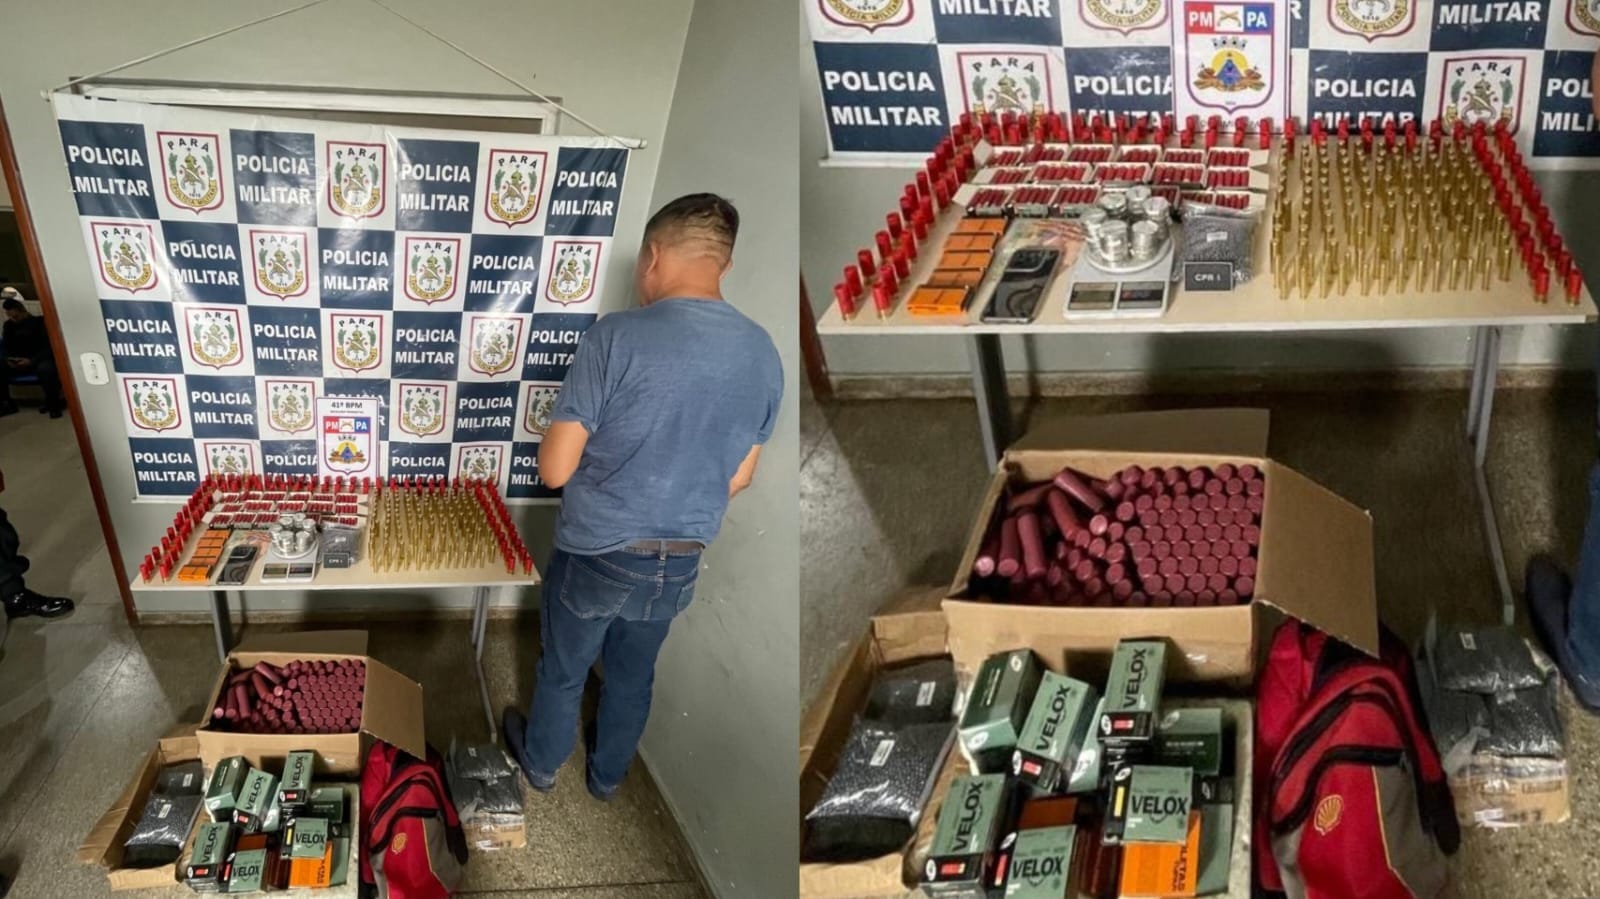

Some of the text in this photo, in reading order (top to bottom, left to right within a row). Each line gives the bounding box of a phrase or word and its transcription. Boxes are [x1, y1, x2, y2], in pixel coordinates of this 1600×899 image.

[938, 0, 1051, 18] MILITAR
[1440, 2, 1540, 25] MILITAR
[1189, 11, 1212, 27] PM
[1246, 12, 1266, 27] PA
[824, 71, 936, 92] POLICIA
[1074, 75, 1172, 95] POLICIA
[1315, 78, 1416, 98] POLICIA
[832, 106, 942, 126] MILITAR
[1542, 112, 1594, 131] MILI
[68, 144, 144, 166] POLICIA
[236, 154, 310, 176] POLICIA
[402, 164, 470, 182] POLICIA
[74, 176, 150, 198] MILITAR
[557, 170, 618, 188] POLICIA
[239, 185, 312, 205] MILITAR
[400, 194, 470, 212] MILITAR
[552, 200, 613, 216] MILITAR
[170, 242, 236, 260] POLICIA
[322, 249, 389, 266] POLICIA
[472, 255, 534, 270] POLICIA
[173, 268, 240, 286] MILITAR
[324, 276, 389, 292] MILITAR
[470, 279, 533, 295] MILITAR
[105, 318, 172, 334] POLICIA
[254, 324, 316, 339] POLICIA
[396, 328, 456, 343] POLICIA
[111, 342, 176, 357] MILITAR
[257, 347, 318, 362] MILITAR
[395, 351, 454, 364] MILITAR
[527, 352, 576, 365] MILITA
[192, 391, 252, 405] POLICIA
[459, 396, 512, 409] POLICIA
[194, 412, 254, 425] MILITAR
[325, 421, 339, 430] PM
[356, 421, 367, 430] PA
[457, 416, 510, 428] MILITAR
[134, 453, 192, 465] POLICIA
[392, 457, 445, 467] POLICIA
[138, 471, 196, 482] MILITAR
[1123, 648, 1146, 708] VELOX
[1036, 684, 1071, 750] VELOX
[292, 756, 304, 788] VELOX
[246, 775, 264, 811] VELOX
[1131, 795, 1188, 816] VELOX
[952, 782, 984, 852] VELOX
[202, 826, 218, 863] VELOX
[295, 833, 325, 844] VELOX
[233, 864, 260, 877] VELOX
[1012, 856, 1064, 878] VELOX
